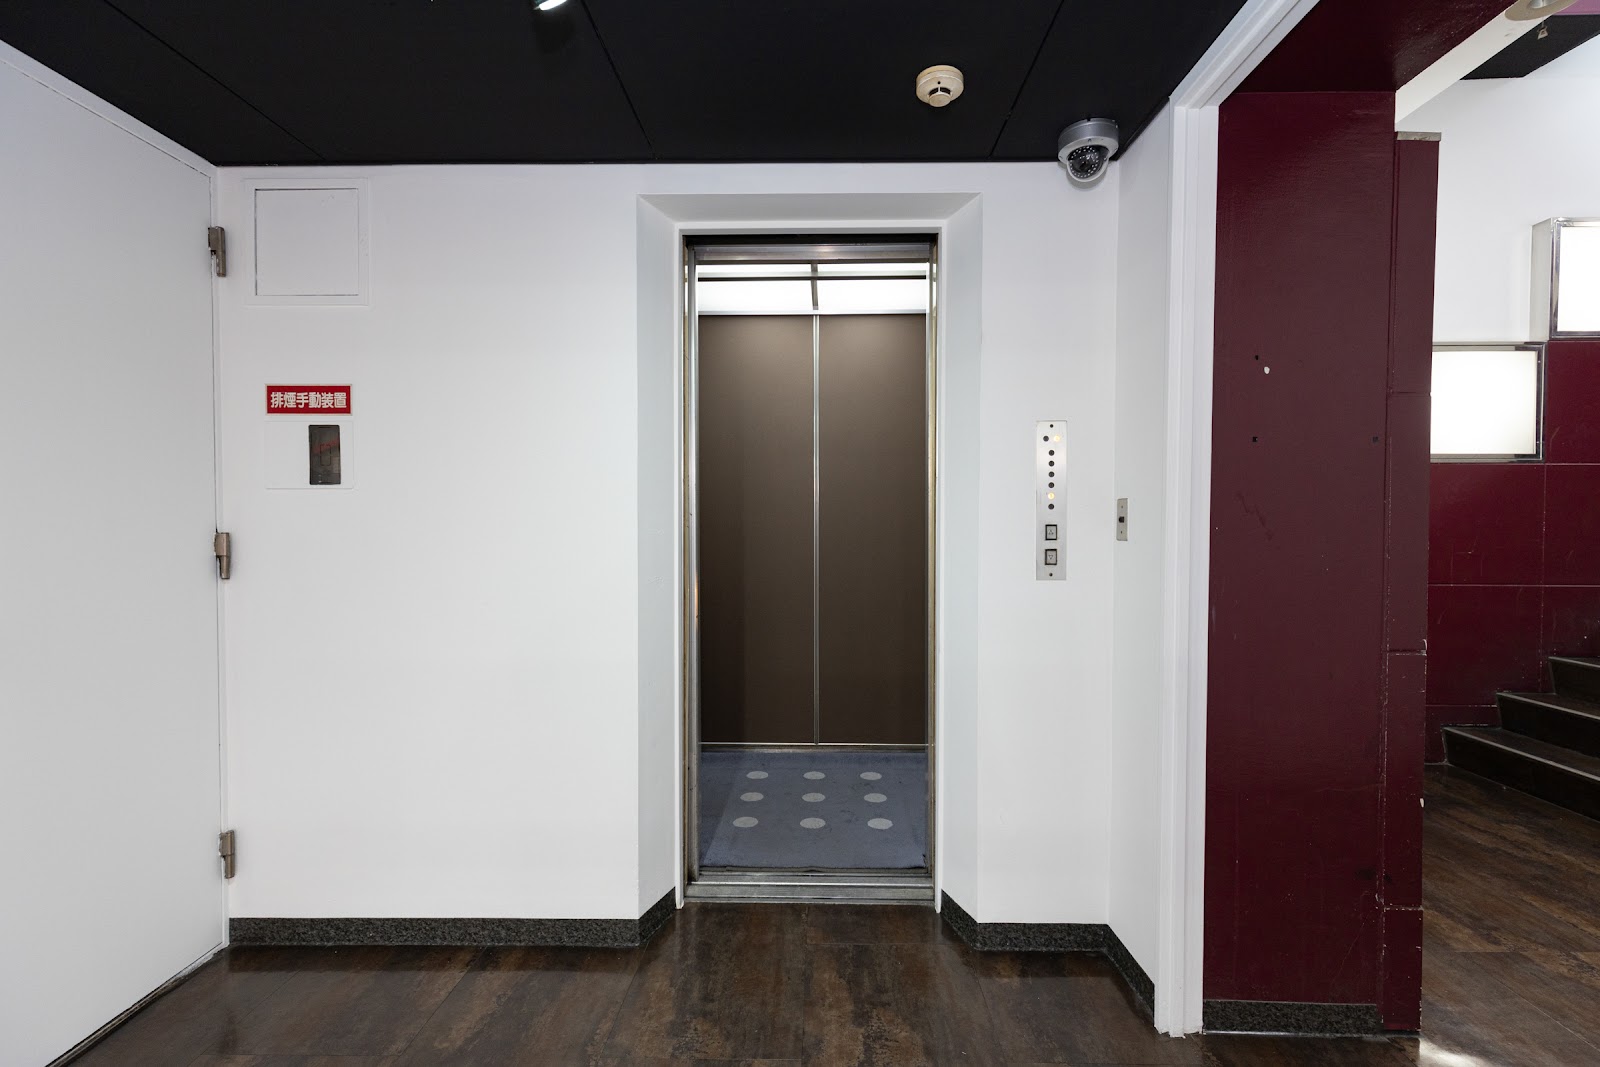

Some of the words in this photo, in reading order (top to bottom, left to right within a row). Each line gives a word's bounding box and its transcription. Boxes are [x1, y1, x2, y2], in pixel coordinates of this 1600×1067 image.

[270, 391, 347, 409] 排煙手動装置
